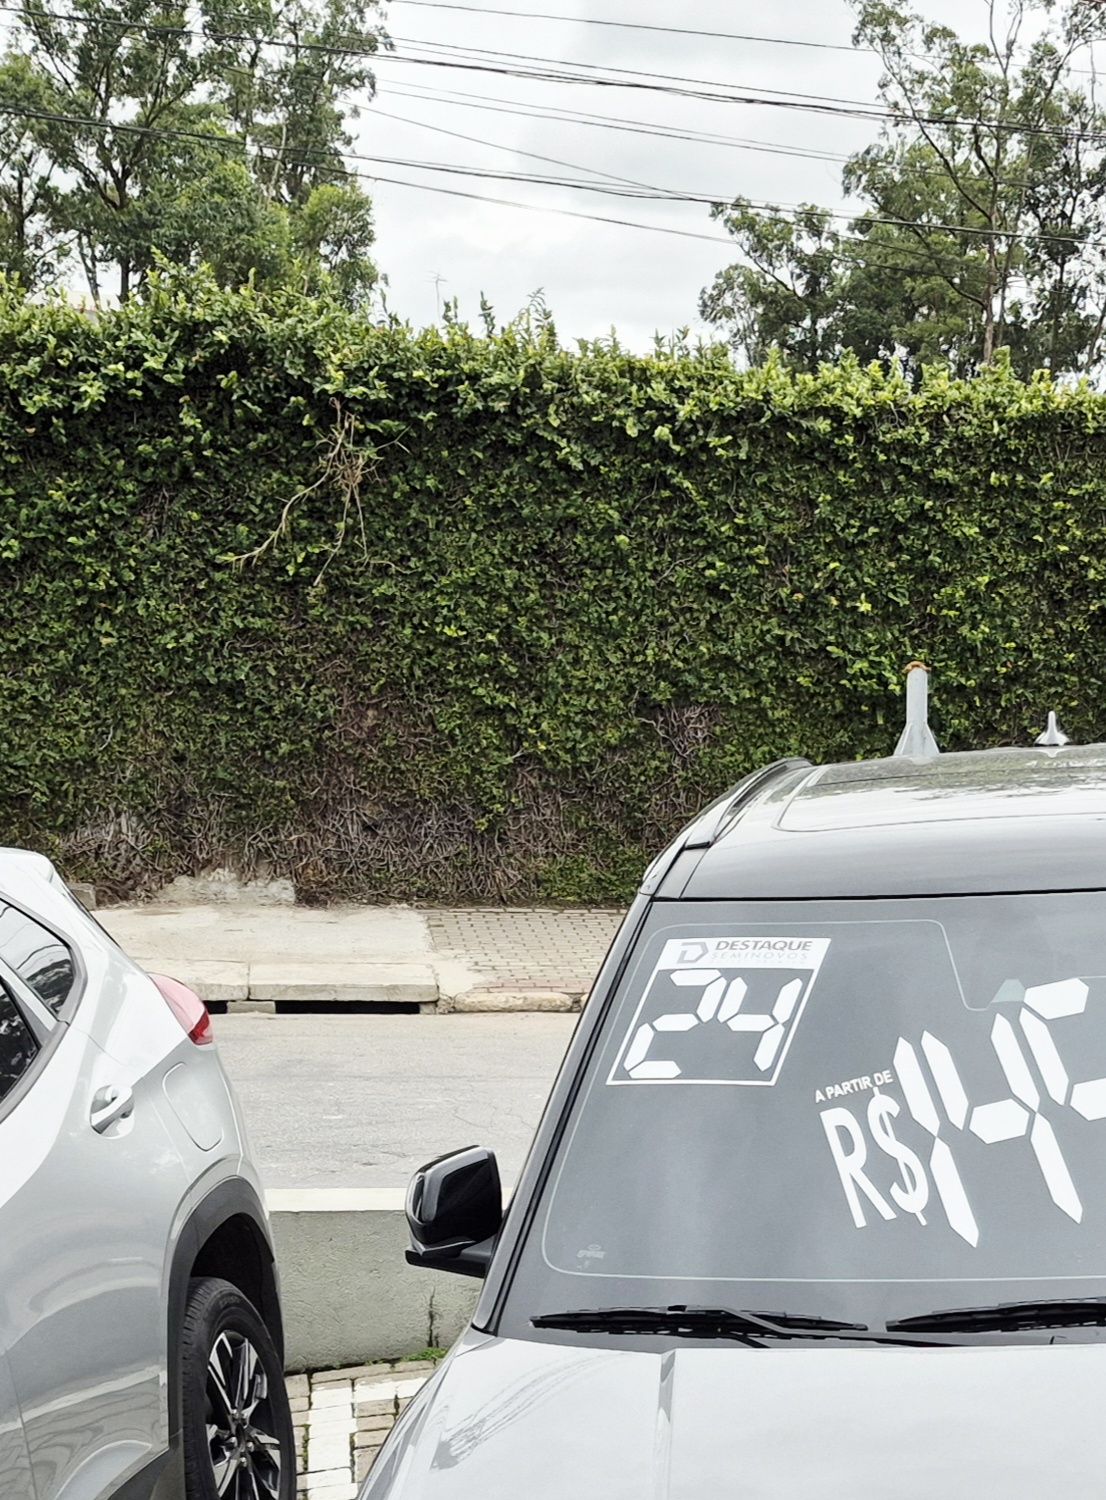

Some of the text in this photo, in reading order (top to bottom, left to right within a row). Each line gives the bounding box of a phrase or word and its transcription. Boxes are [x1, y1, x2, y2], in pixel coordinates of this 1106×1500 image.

[710, 951, 809, 960] SEMINOVOS
[714, 939, 814, 952] DESTAQUE
[622, 968, 804, 1079] 24
[815, 1070, 894, 1104] A PARTIR DE
